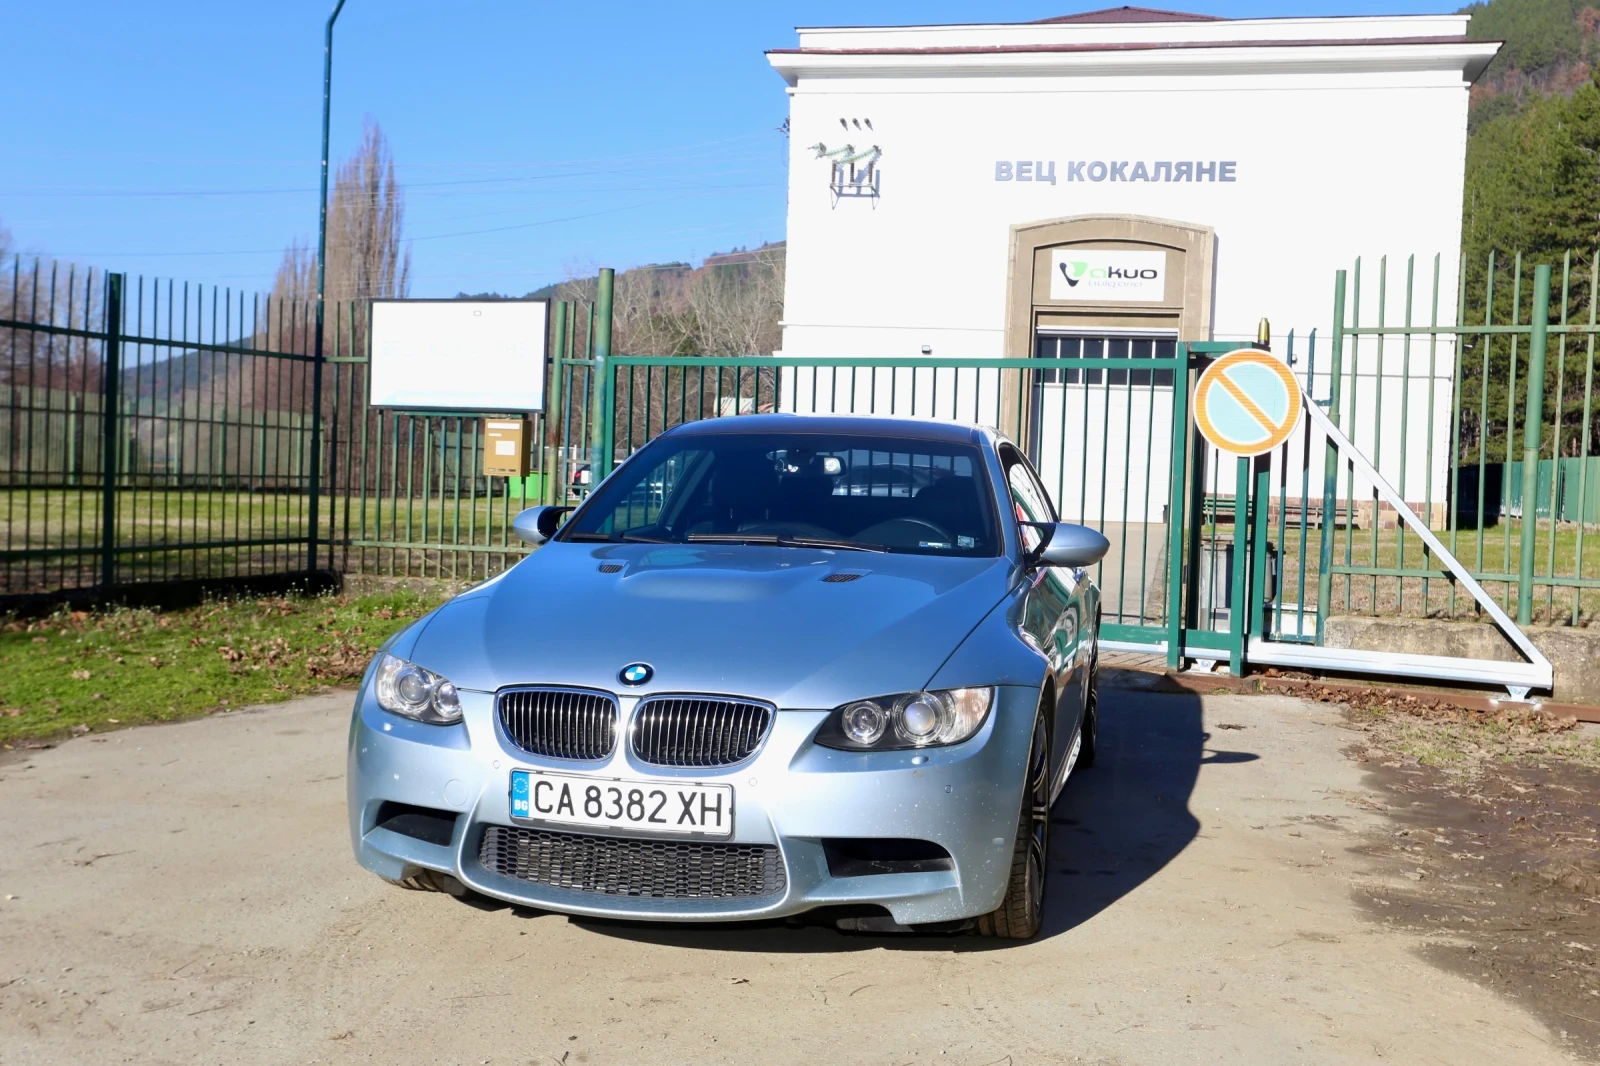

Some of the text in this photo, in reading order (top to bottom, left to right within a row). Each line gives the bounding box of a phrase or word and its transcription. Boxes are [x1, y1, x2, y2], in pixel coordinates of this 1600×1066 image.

[995, 160, 1237, 186] ВЕЦ КОКАЛЯНЕ
[1089, 265, 1158, 279] akuo
[514, 799, 528, 811] BG
[534, 780, 722, 826] CA 8382 XH
